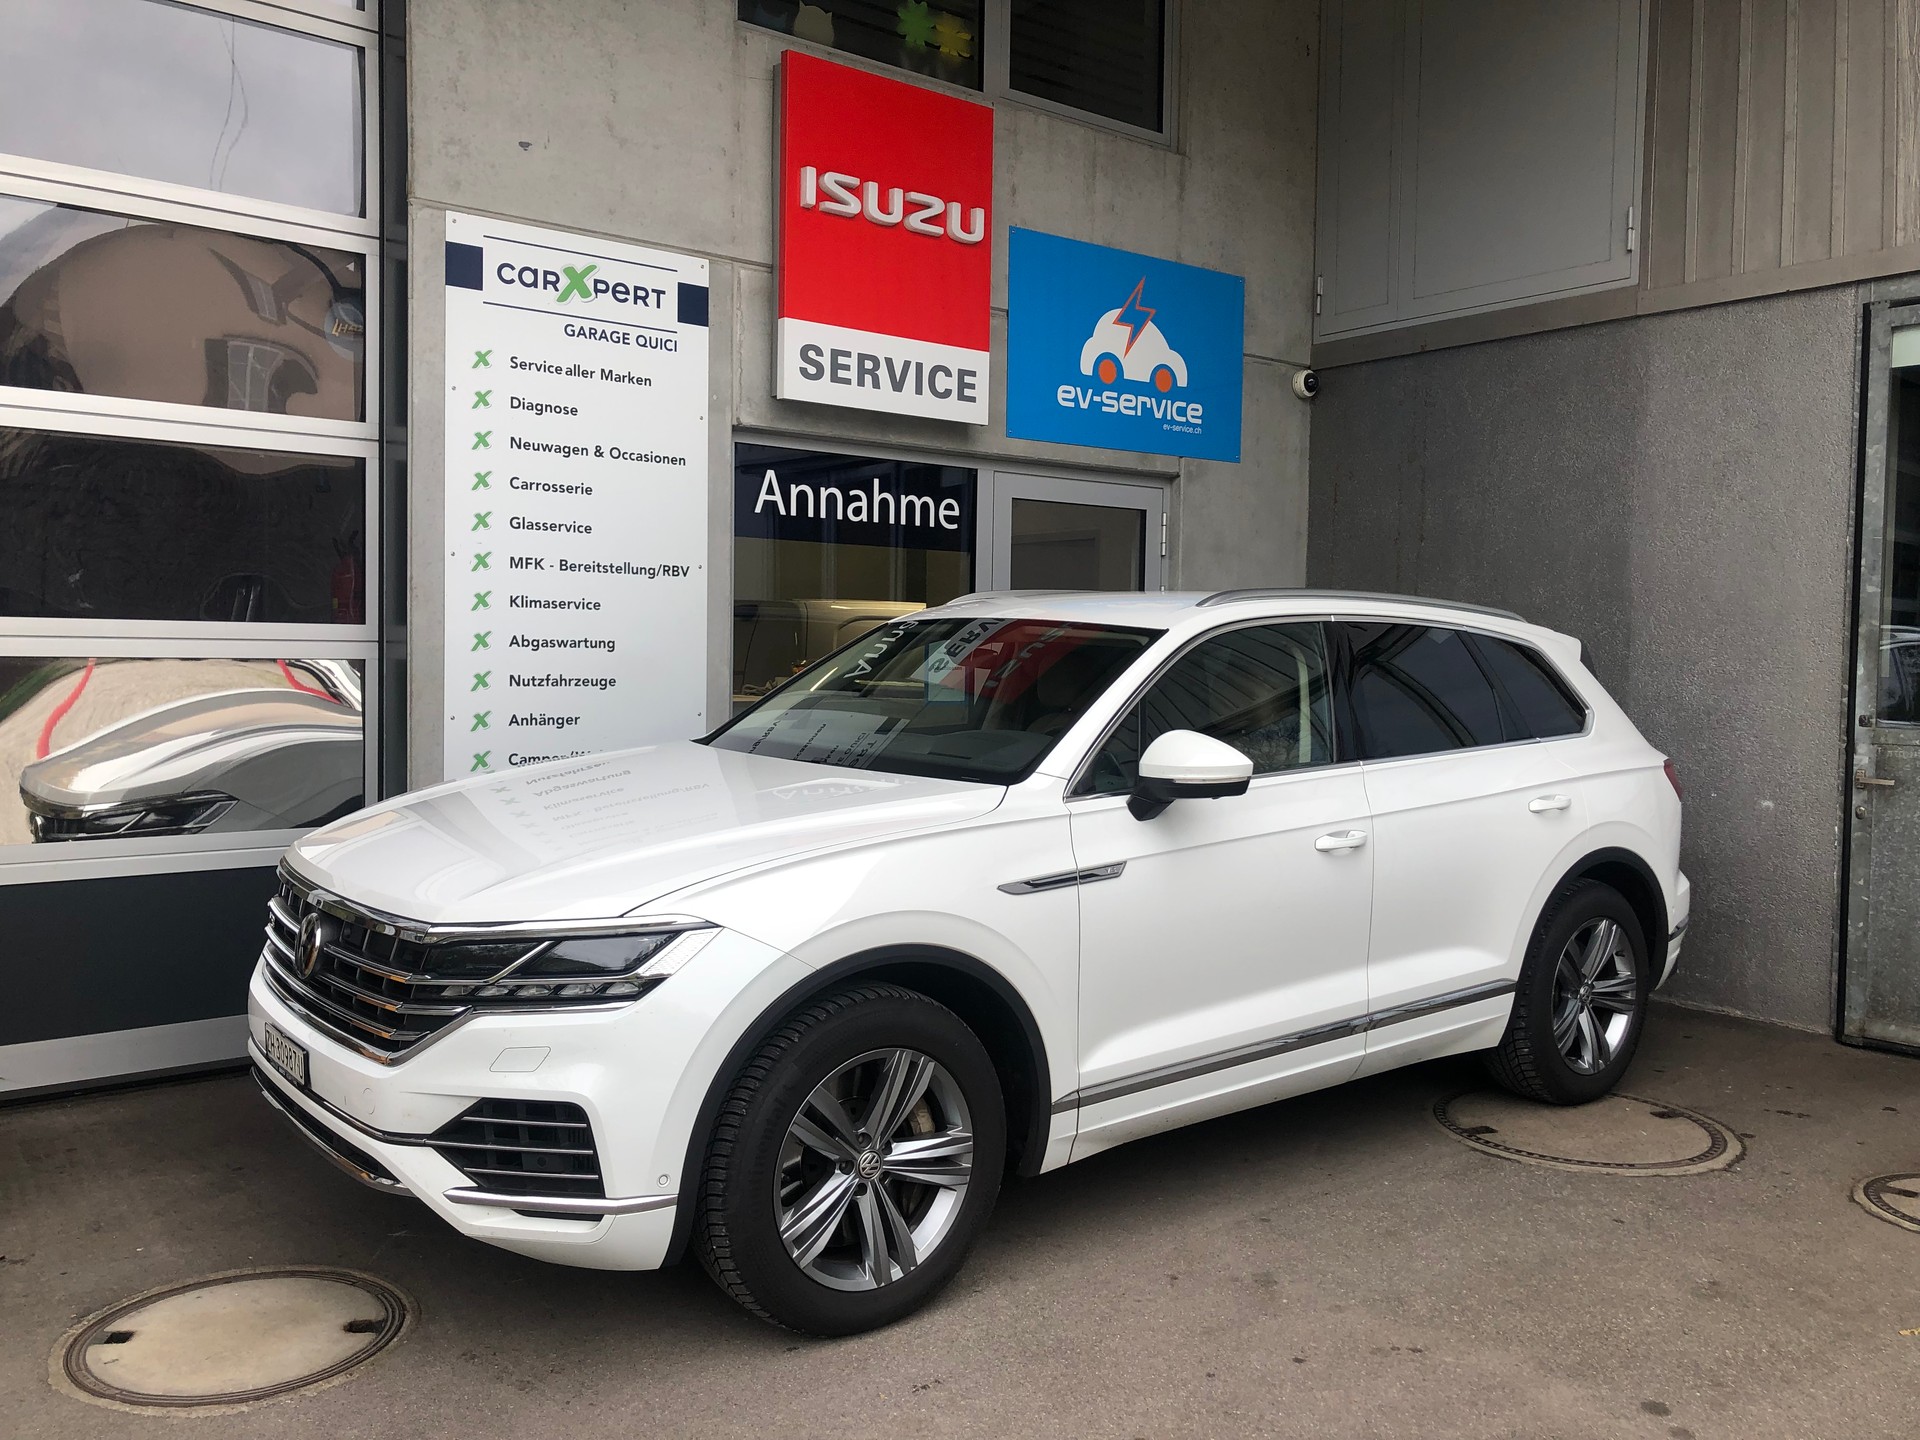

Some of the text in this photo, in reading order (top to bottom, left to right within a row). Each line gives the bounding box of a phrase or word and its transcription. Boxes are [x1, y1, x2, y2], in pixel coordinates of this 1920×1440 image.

[800, 165, 985, 245] ISUZU
[563, 323, 678, 353] GARAGE QUICI
[509, 356, 652, 387] Service aller Marken
[799, 343, 978, 404] SERVICE
[509, 396, 579, 417] Diagnose
[1057, 384, 1203, 425] ev-service
[1163, 423, 1202, 435] ev-service.ch
[509, 436, 687, 466] Neuwagen & Occasionen
[509, 477, 593, 496] Carrosserie
[754, 468, 961, 530] Annahme
[509, 516, 593, 534] Glasservice
[509, 556, 545, 571] MFK
[558, 559, 691, 579] Bereitstellung/RBV
[509, 595, 602, 611] Klimaservice
[508, 635, 616, 652] Abgaswartung
[508, 674, 617, 692] Nutzfahrzeuge
[508, 713, 581, 729] Anhänger
